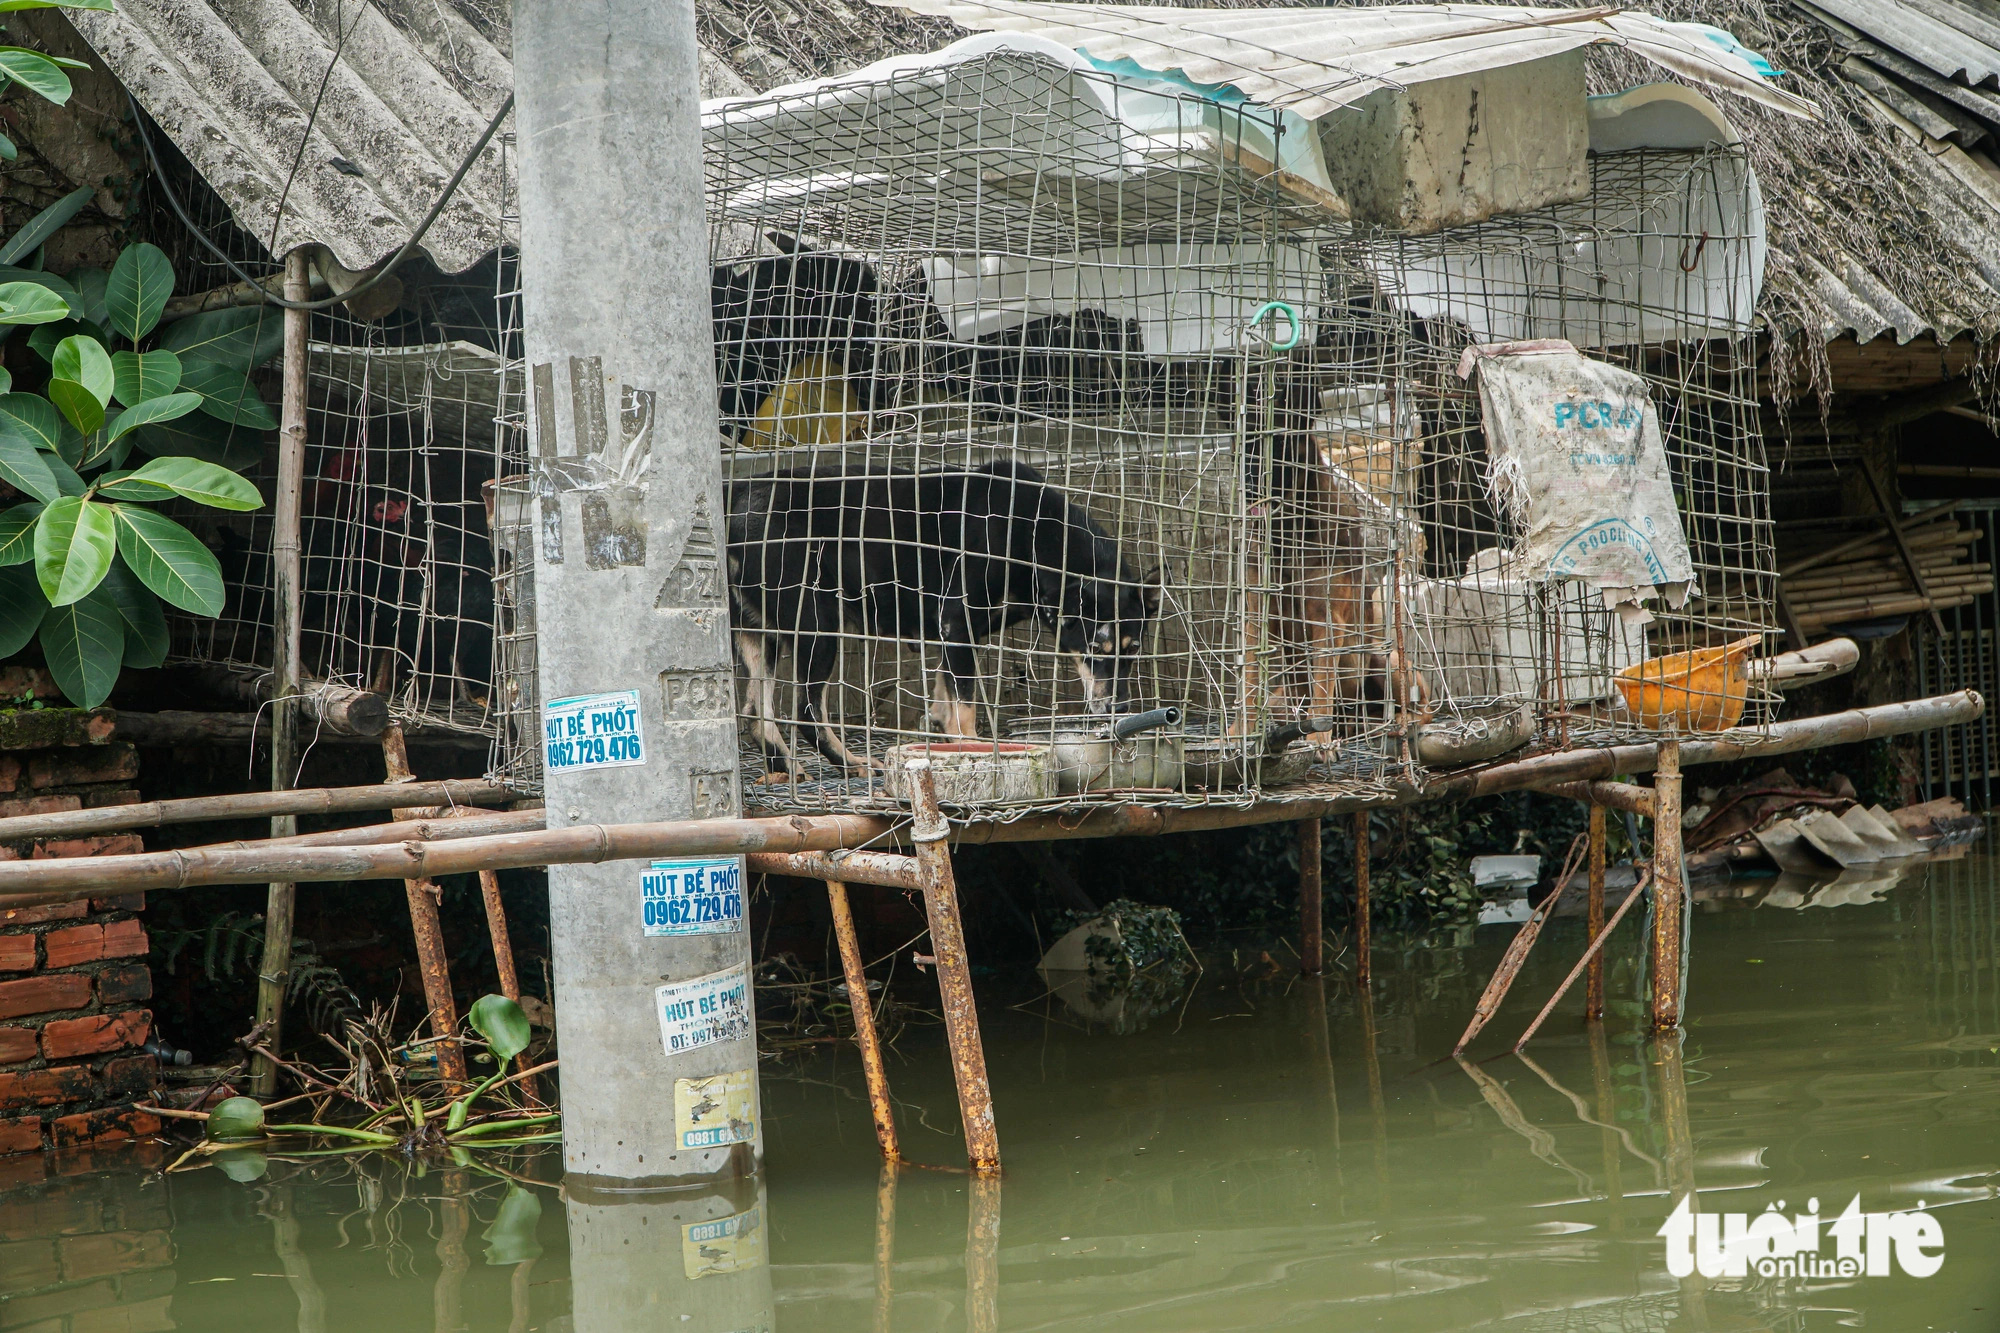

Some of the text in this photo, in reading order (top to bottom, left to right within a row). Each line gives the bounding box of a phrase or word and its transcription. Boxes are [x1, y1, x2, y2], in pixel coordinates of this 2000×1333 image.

[546, 705, 637, 739] HÚT BỂ PHỐT
[547, 735, 641, 767] 0962.729.476
[642, 864, 739, 897] HÚT BỂ PHỐT
[644, 893, 741, 926] 0962.729.476
[664, 998, 694, 1022] HÚT
[699, 987, 718, 1015] BỂ
[686, 1130, 715, 1146] 0981
